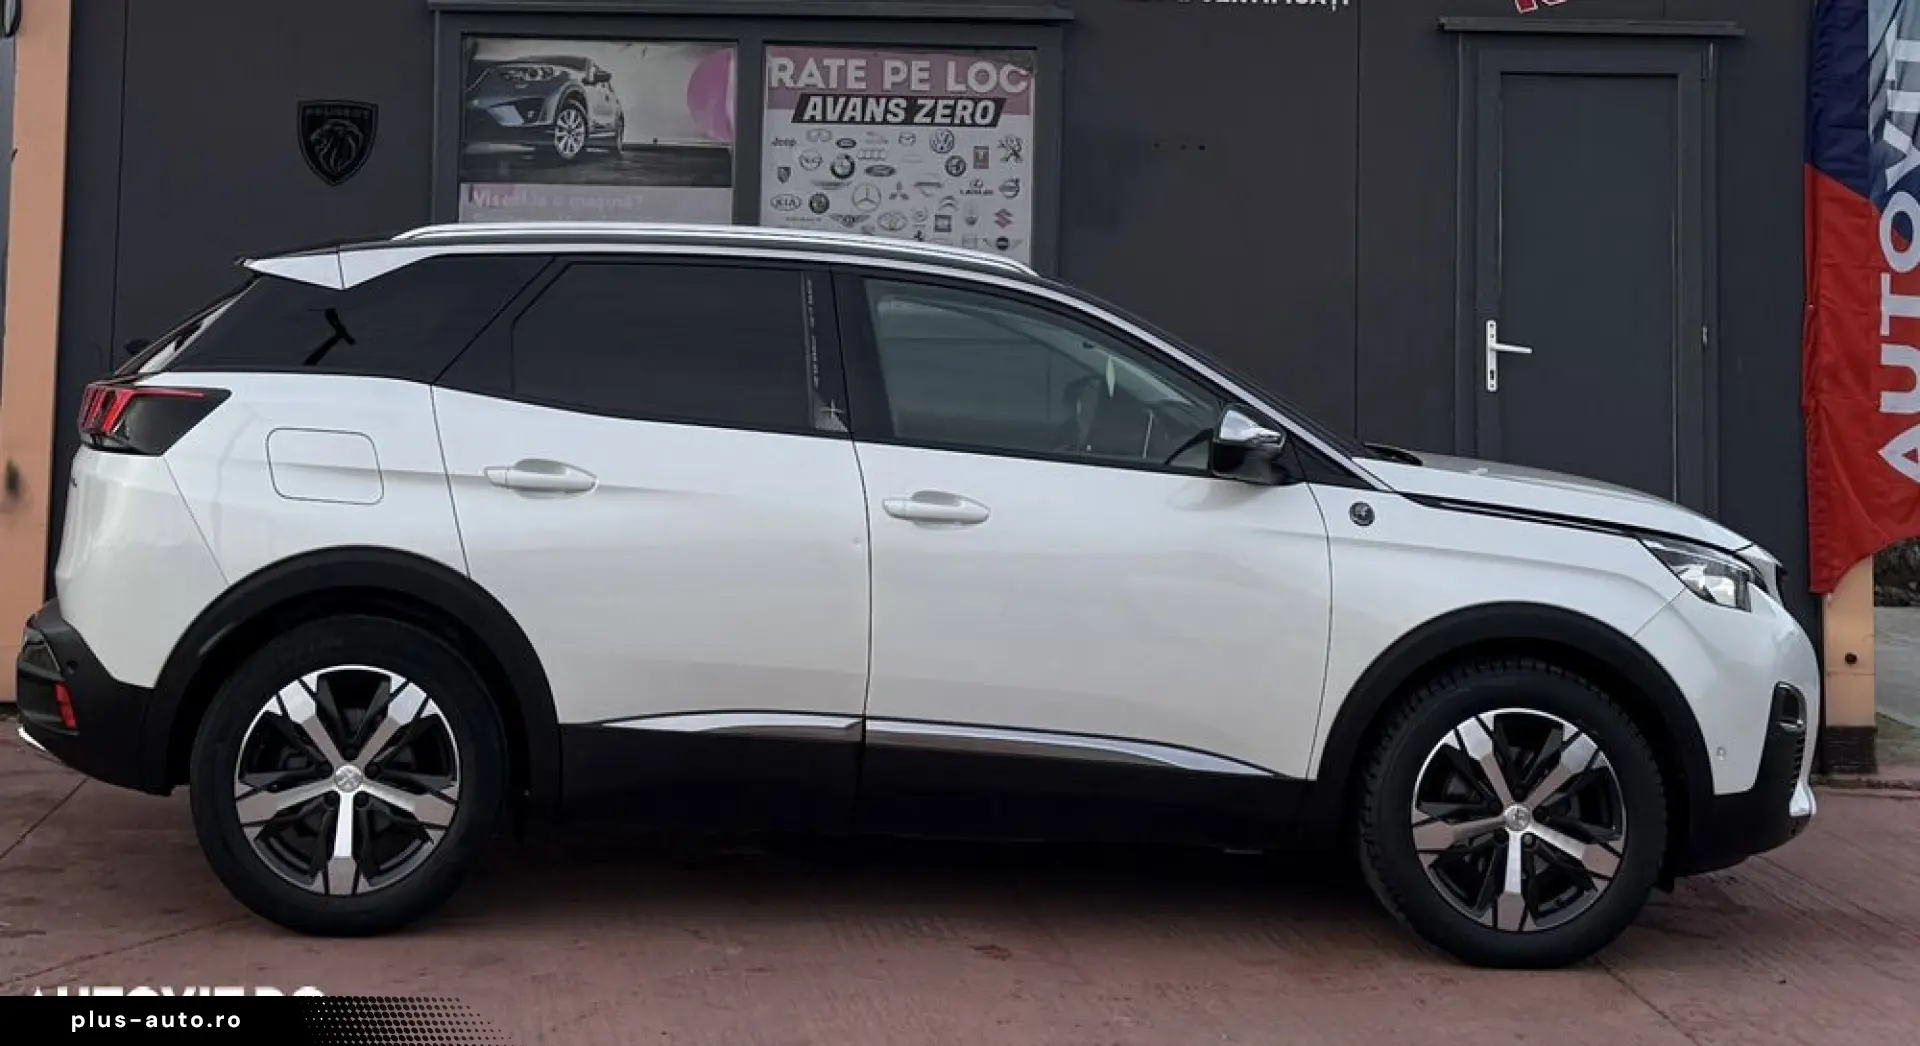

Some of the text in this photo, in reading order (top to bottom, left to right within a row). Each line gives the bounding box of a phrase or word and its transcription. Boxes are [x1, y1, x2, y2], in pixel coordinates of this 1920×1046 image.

[769, 56, 1029, 93] RATE PE LOC
[803, 96, 997, 125] AVANS ZERO
[1878, 19, 1920, 483] AUTOVIT
